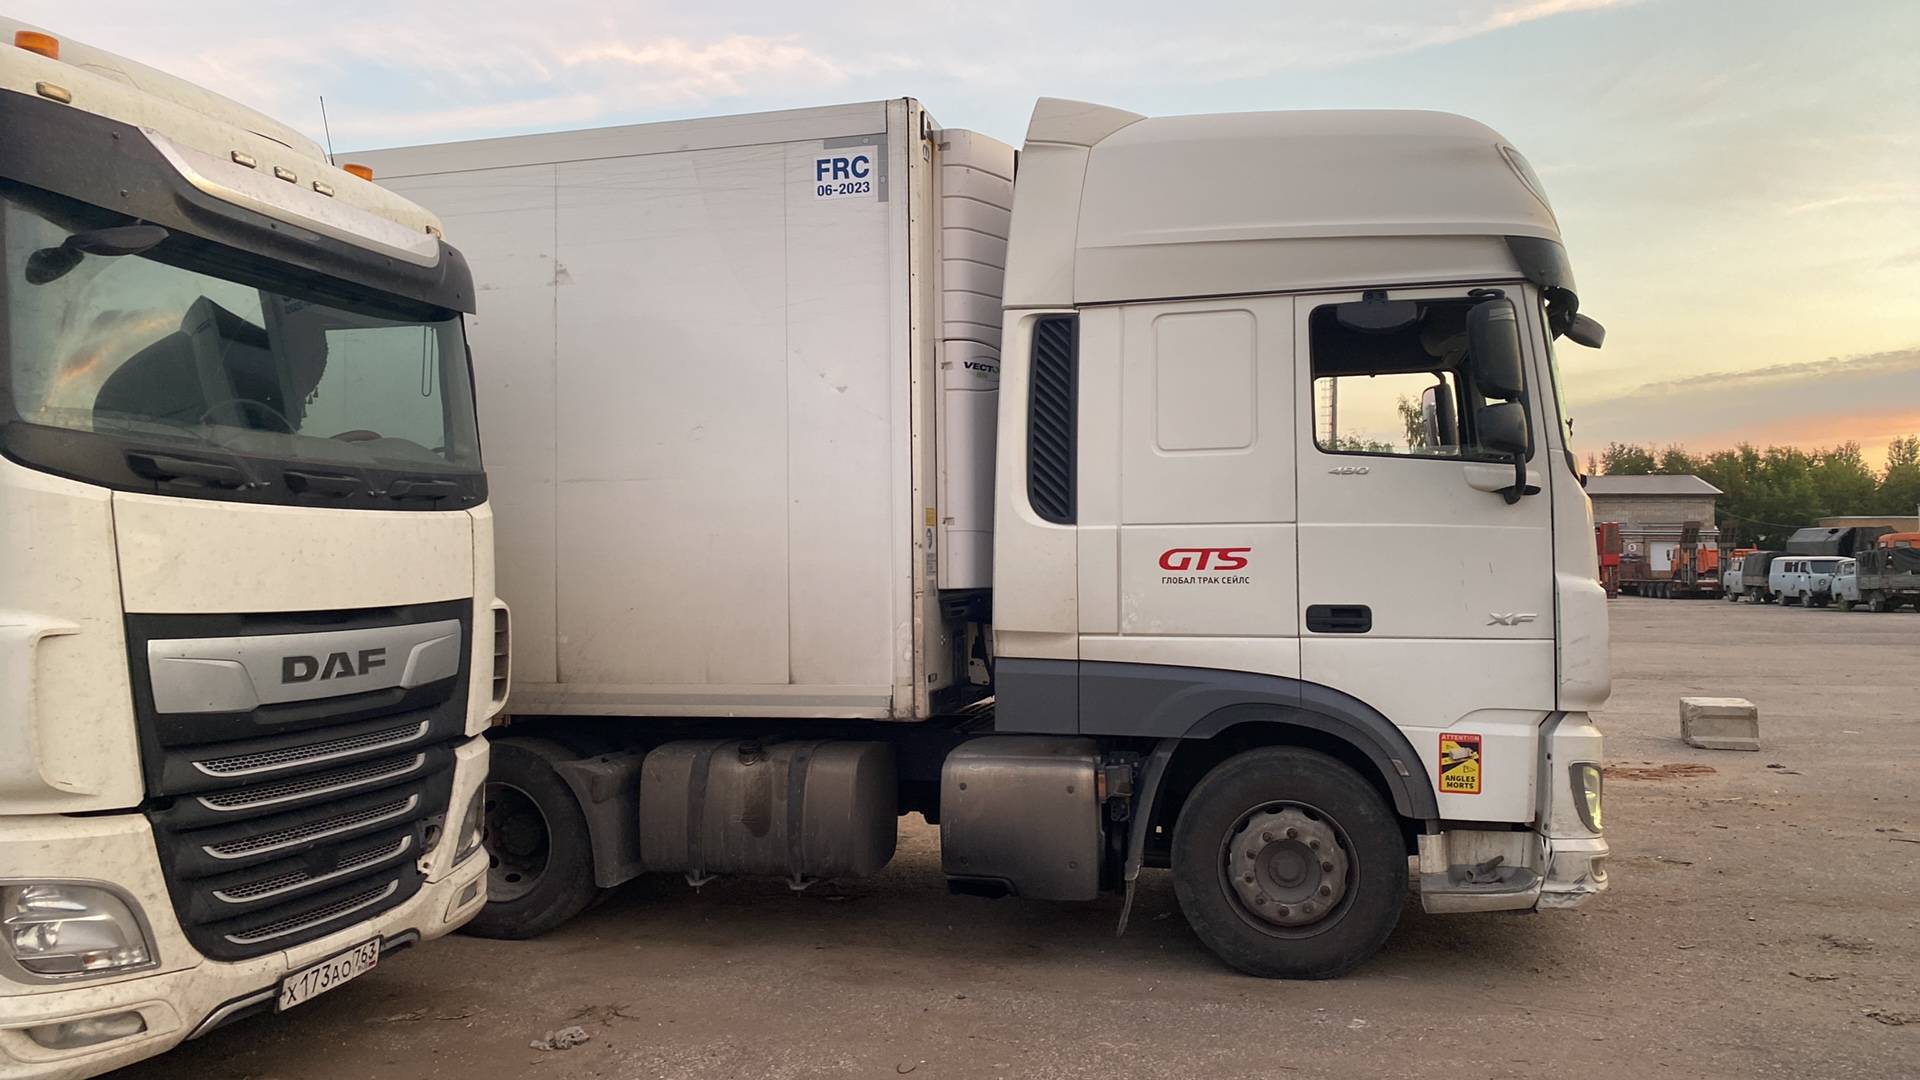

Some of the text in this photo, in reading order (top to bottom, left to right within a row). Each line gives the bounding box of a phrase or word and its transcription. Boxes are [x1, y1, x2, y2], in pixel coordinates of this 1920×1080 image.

[816, 155, 870, 181] FRC
[817, 181, 870, 197] 06-2023
[1159, 547, 1252, 571] GTS
[1161, 575, 1251, 585] ГЛОБАЛ ТРАК СЕЙЛС
[1486, 612, 1537, 626] XF
[281, 647, 386, 685] DAF
